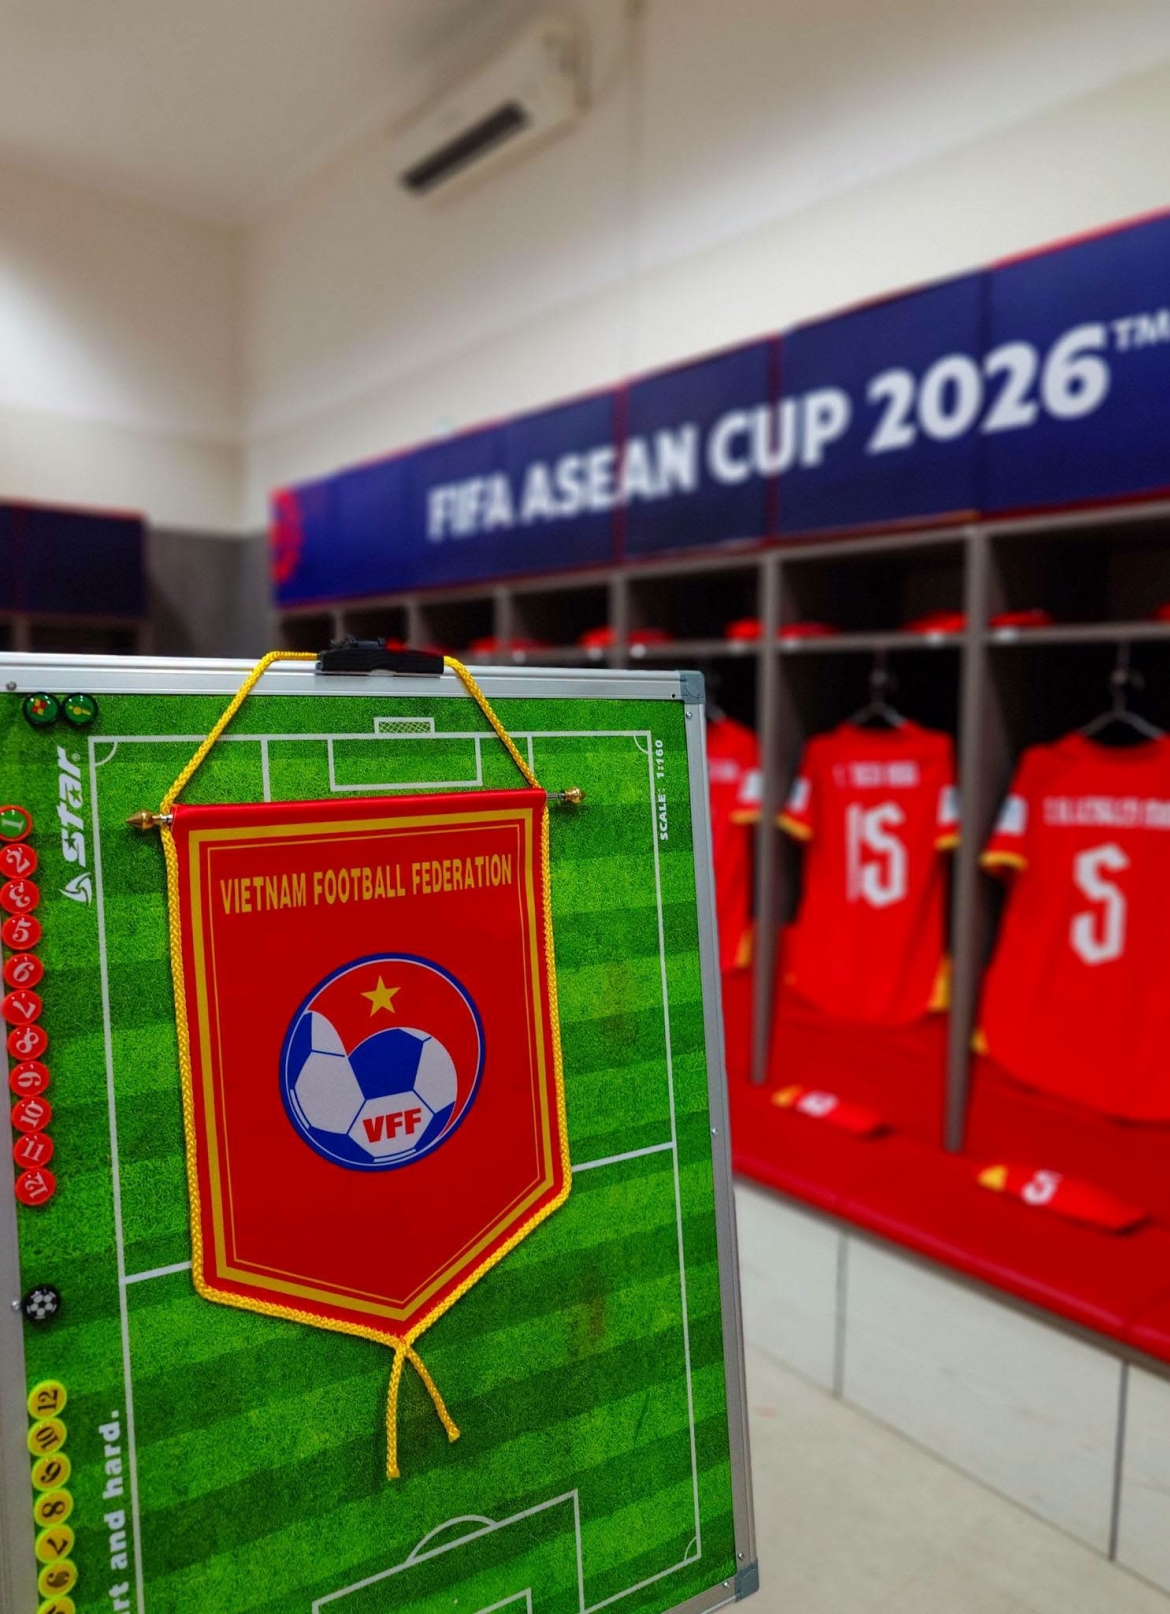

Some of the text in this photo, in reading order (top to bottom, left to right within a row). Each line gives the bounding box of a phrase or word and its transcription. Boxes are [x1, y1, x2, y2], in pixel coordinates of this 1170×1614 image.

[427, 474, 513, 541] FIFA
[521, 424, 698, 522] ASEAN
[708, 387, 850, 483] CUP
[6, 850, 30, 873] 2
[9, 883, 30, 907] 3
[220, 854, 511, 914] VIETNAM FOOTBALL FEDERATION
[1071, 842, 1130, 966] 5
[13, 920, 31, 942] 5
[13, 962, 35, 982] 6
[12, 1001, 36, 1019] 7
[16, 1032, 40, 1054] 8
[17, 1071, 42, 1087] 9
[20, 1103, 44, 1128] 10
[363, 1108, 421, 1143] VFF
[22, 1140, 45, 1161] 11
[24, 1172, 48, 1199] 12
[37, 1389, 58, 1412] 12
[35, 1426, 59, 1450] 10
[41, 1500, 65, 1518] 8
[98, 1410, 130, 1614] rt and hard.
[46, 1536, 68, 1555] 7
